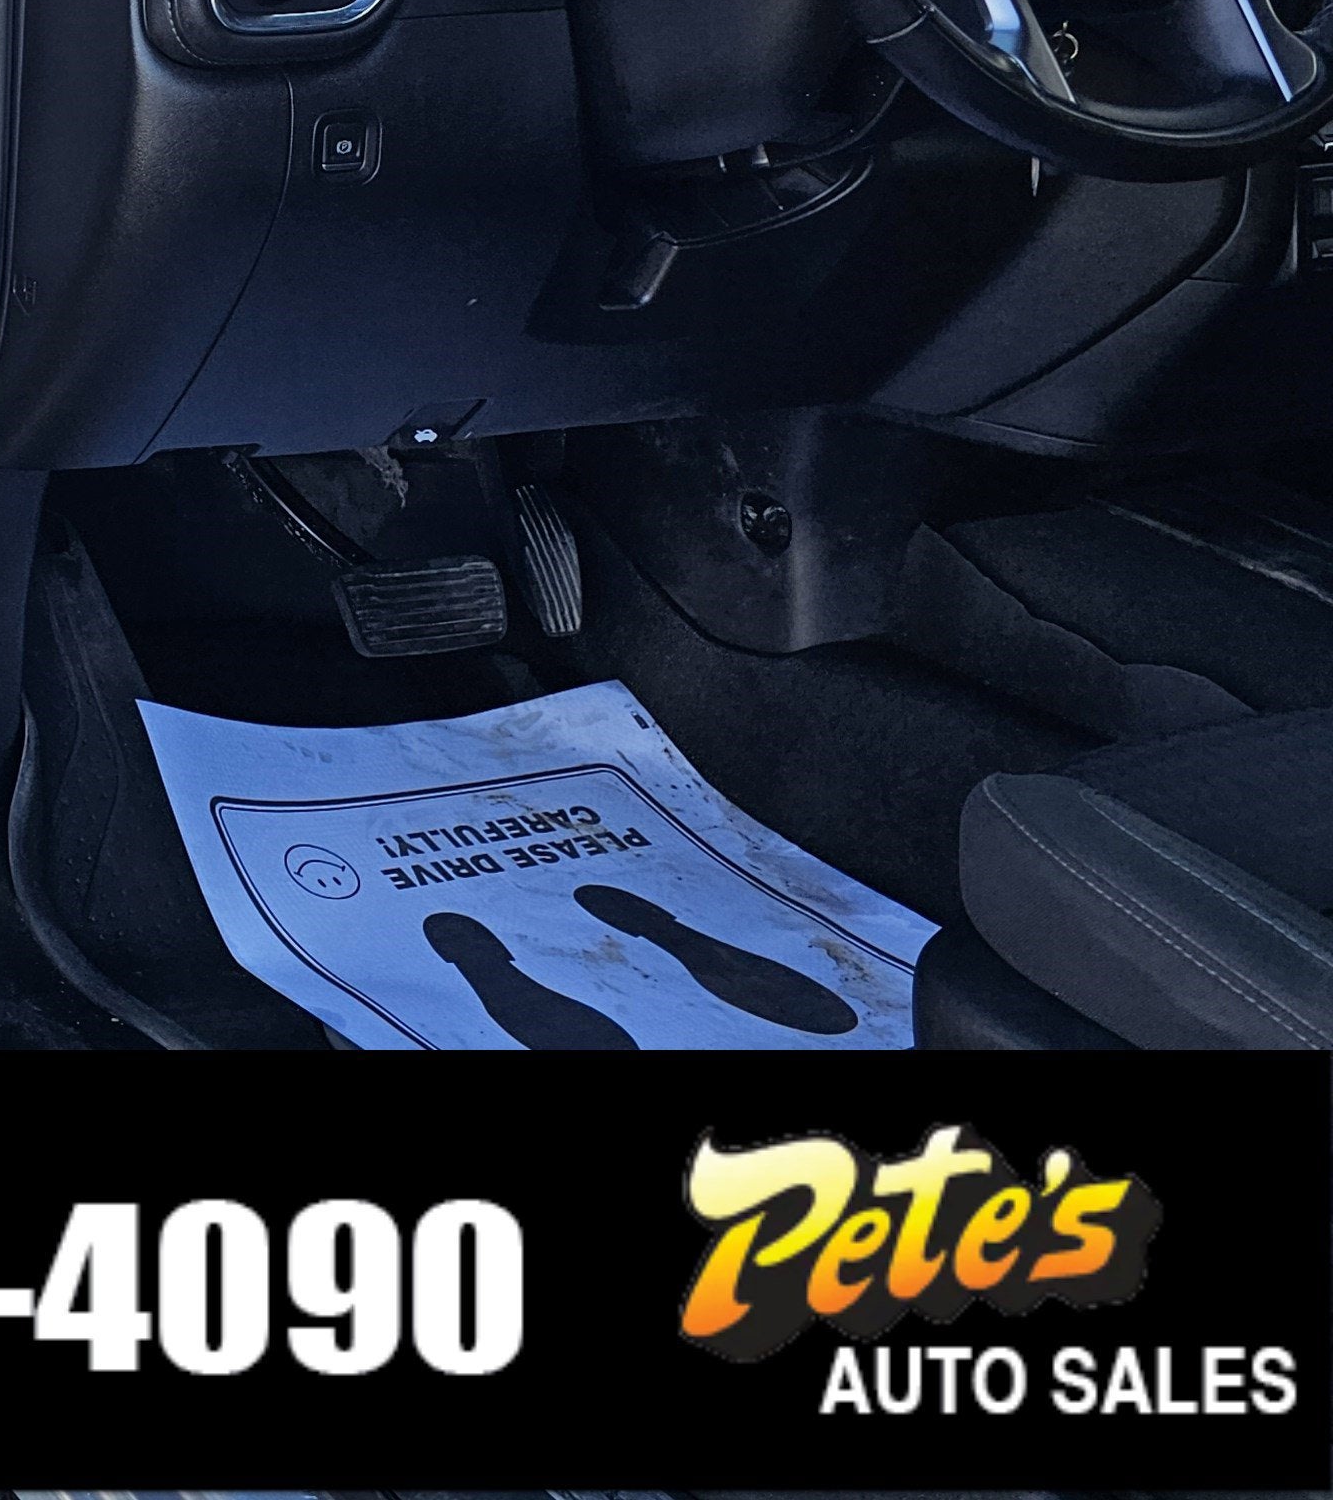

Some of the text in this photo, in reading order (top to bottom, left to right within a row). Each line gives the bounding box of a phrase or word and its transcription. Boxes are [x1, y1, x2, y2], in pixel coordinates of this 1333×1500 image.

[375, 805, 601, 859] CAREFULLY!
[381, 827, 653, 891] PLEASE DRIVE
